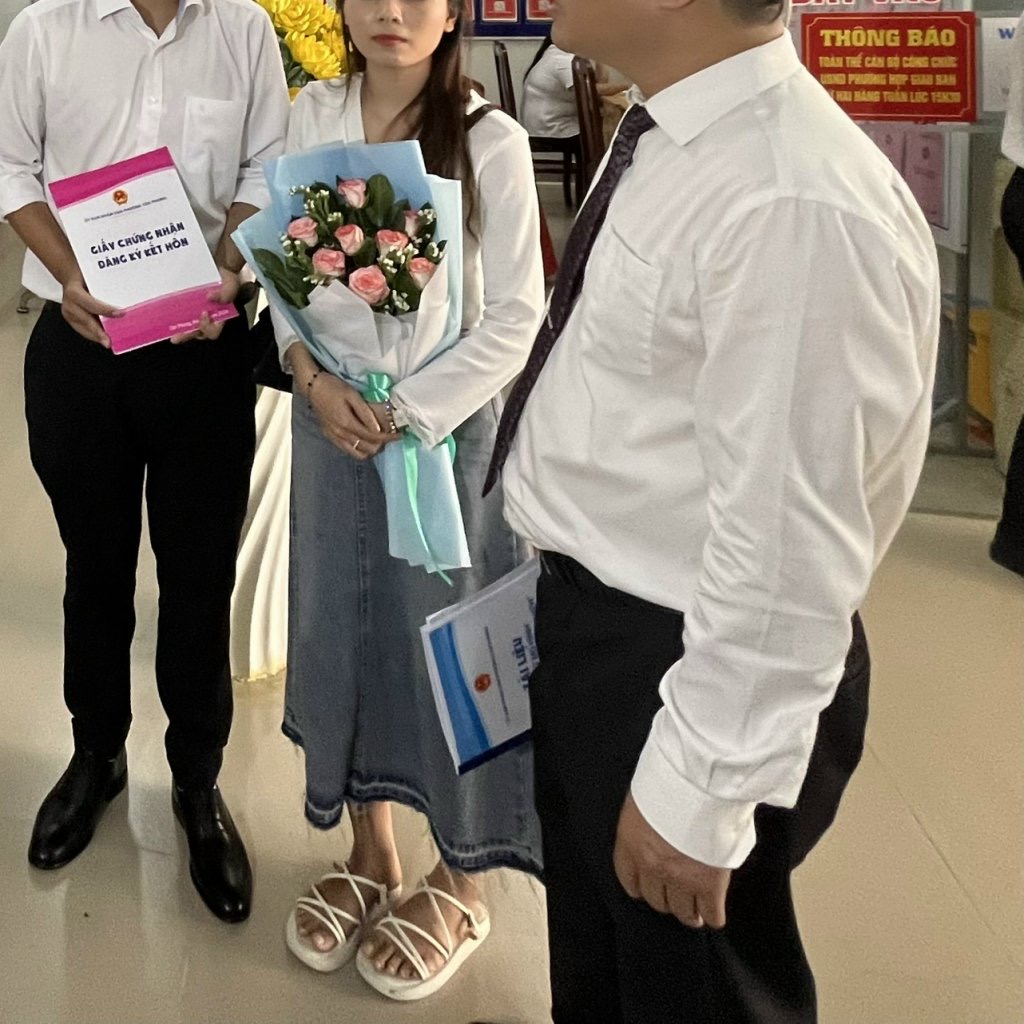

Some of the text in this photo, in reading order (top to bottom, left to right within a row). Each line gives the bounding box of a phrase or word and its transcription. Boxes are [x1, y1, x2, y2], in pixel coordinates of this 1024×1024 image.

[820, 26, 956, 47] THÔNG BÁO
[117, 232, 154, 248] CHỨNG
[128, 247, 142, 261] KÝ
[144, 241, 163, 257] KẾT
